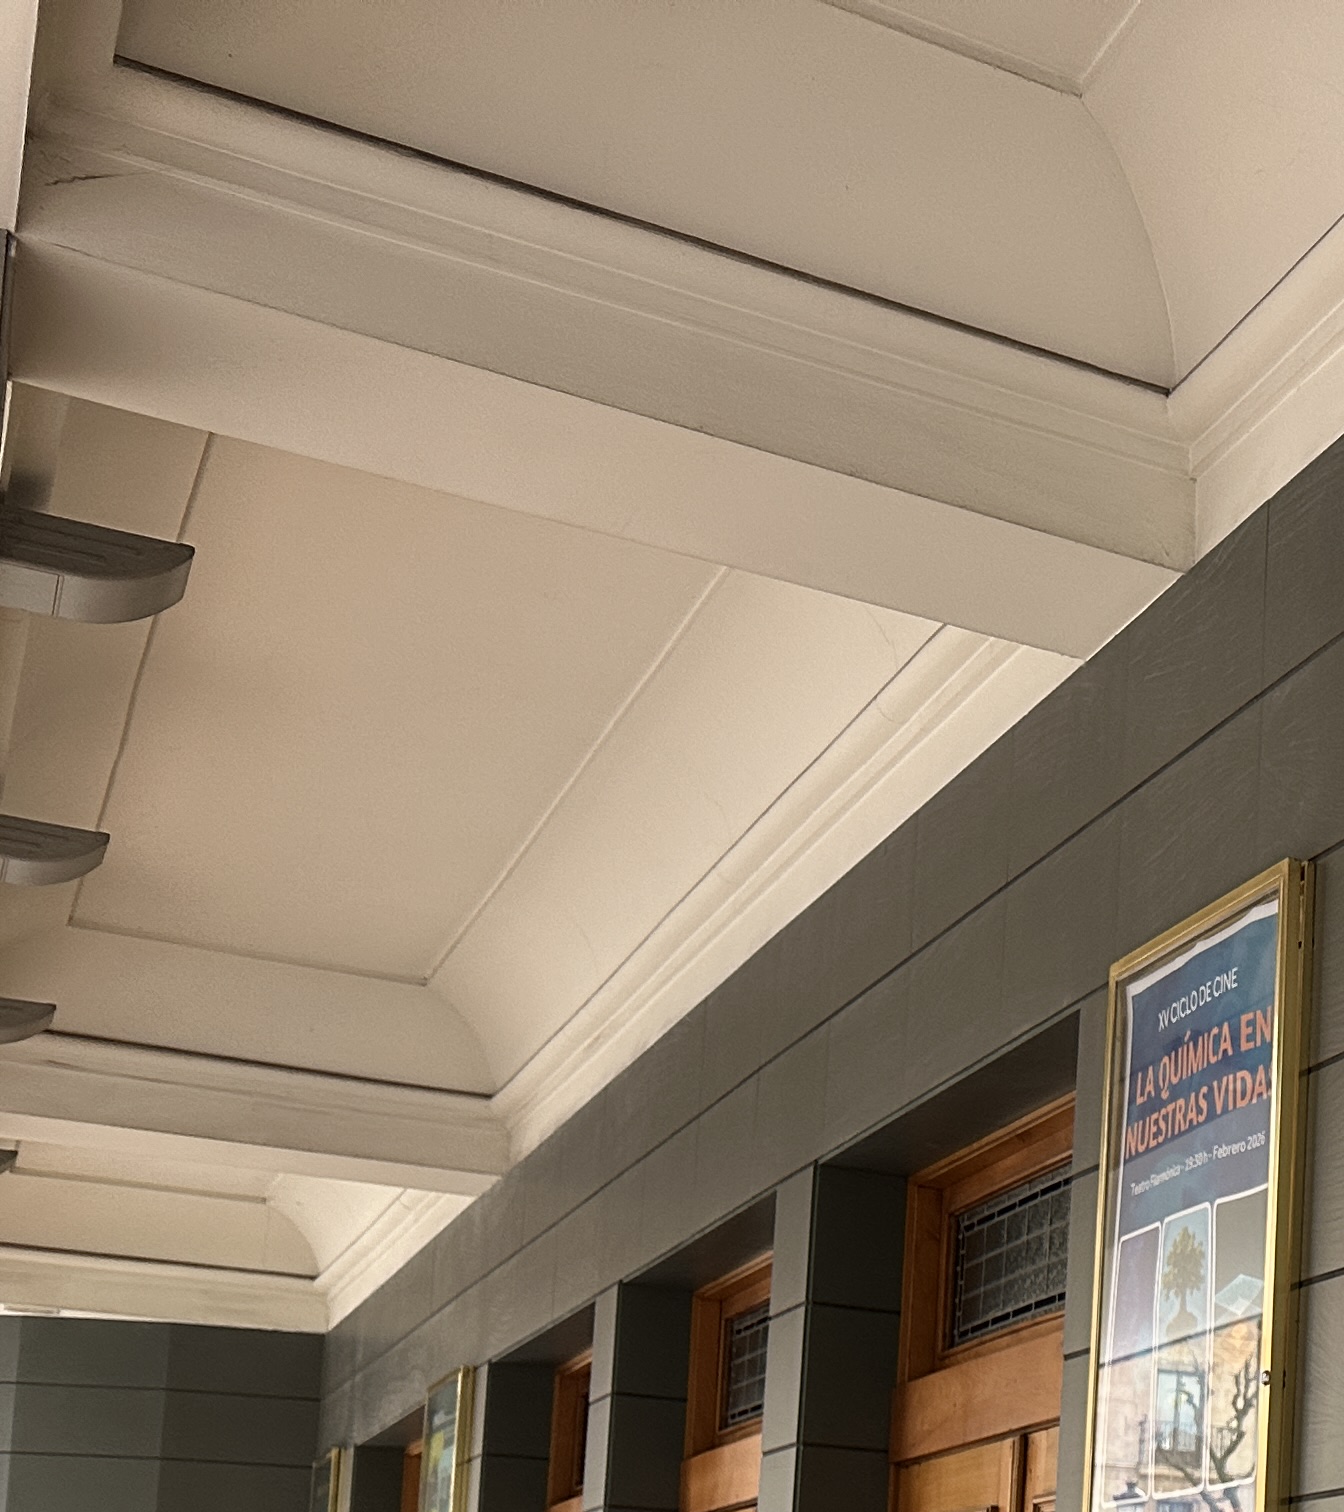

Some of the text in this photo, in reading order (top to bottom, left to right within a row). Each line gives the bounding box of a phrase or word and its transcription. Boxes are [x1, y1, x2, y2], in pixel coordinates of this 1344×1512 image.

[1157, 966, 1239, 1032] XV CICLO DE CINE
[1136, 1005, 1272, 1106] LA QUÍMICA EN
[1125, 1084, 1209, 1160] NUESTRAS
[1212, 1141, 1247, 1161] Febrero
